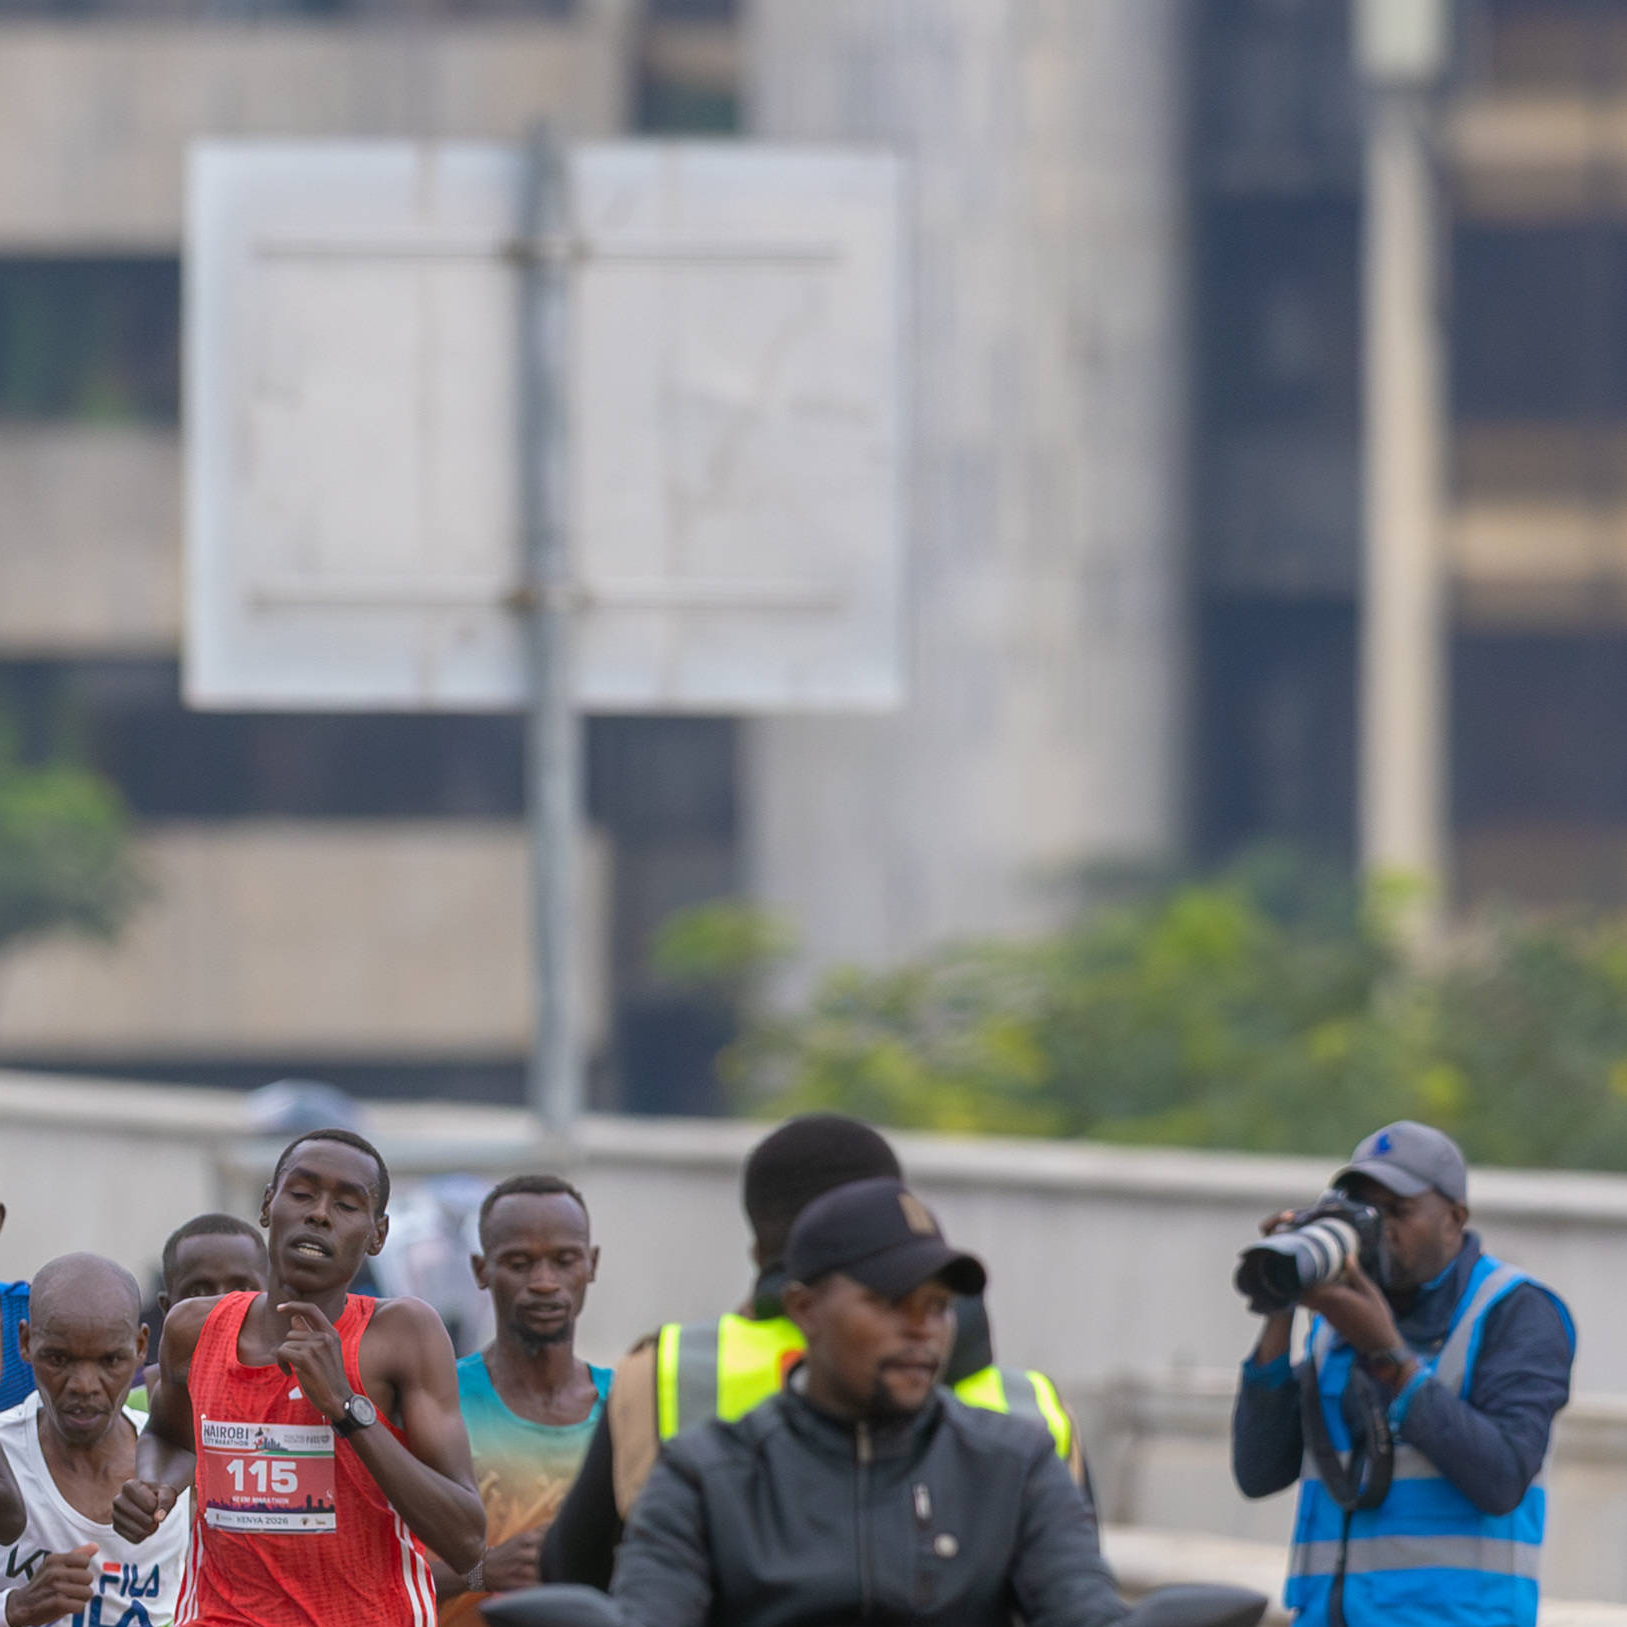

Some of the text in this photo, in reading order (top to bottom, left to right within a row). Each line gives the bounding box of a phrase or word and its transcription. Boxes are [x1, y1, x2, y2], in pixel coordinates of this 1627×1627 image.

[204, 1424, 249, 1439] NAIROBI
[226, 1459, 298, 1493] 115
[99, 1562, 160, 1598] FILA
